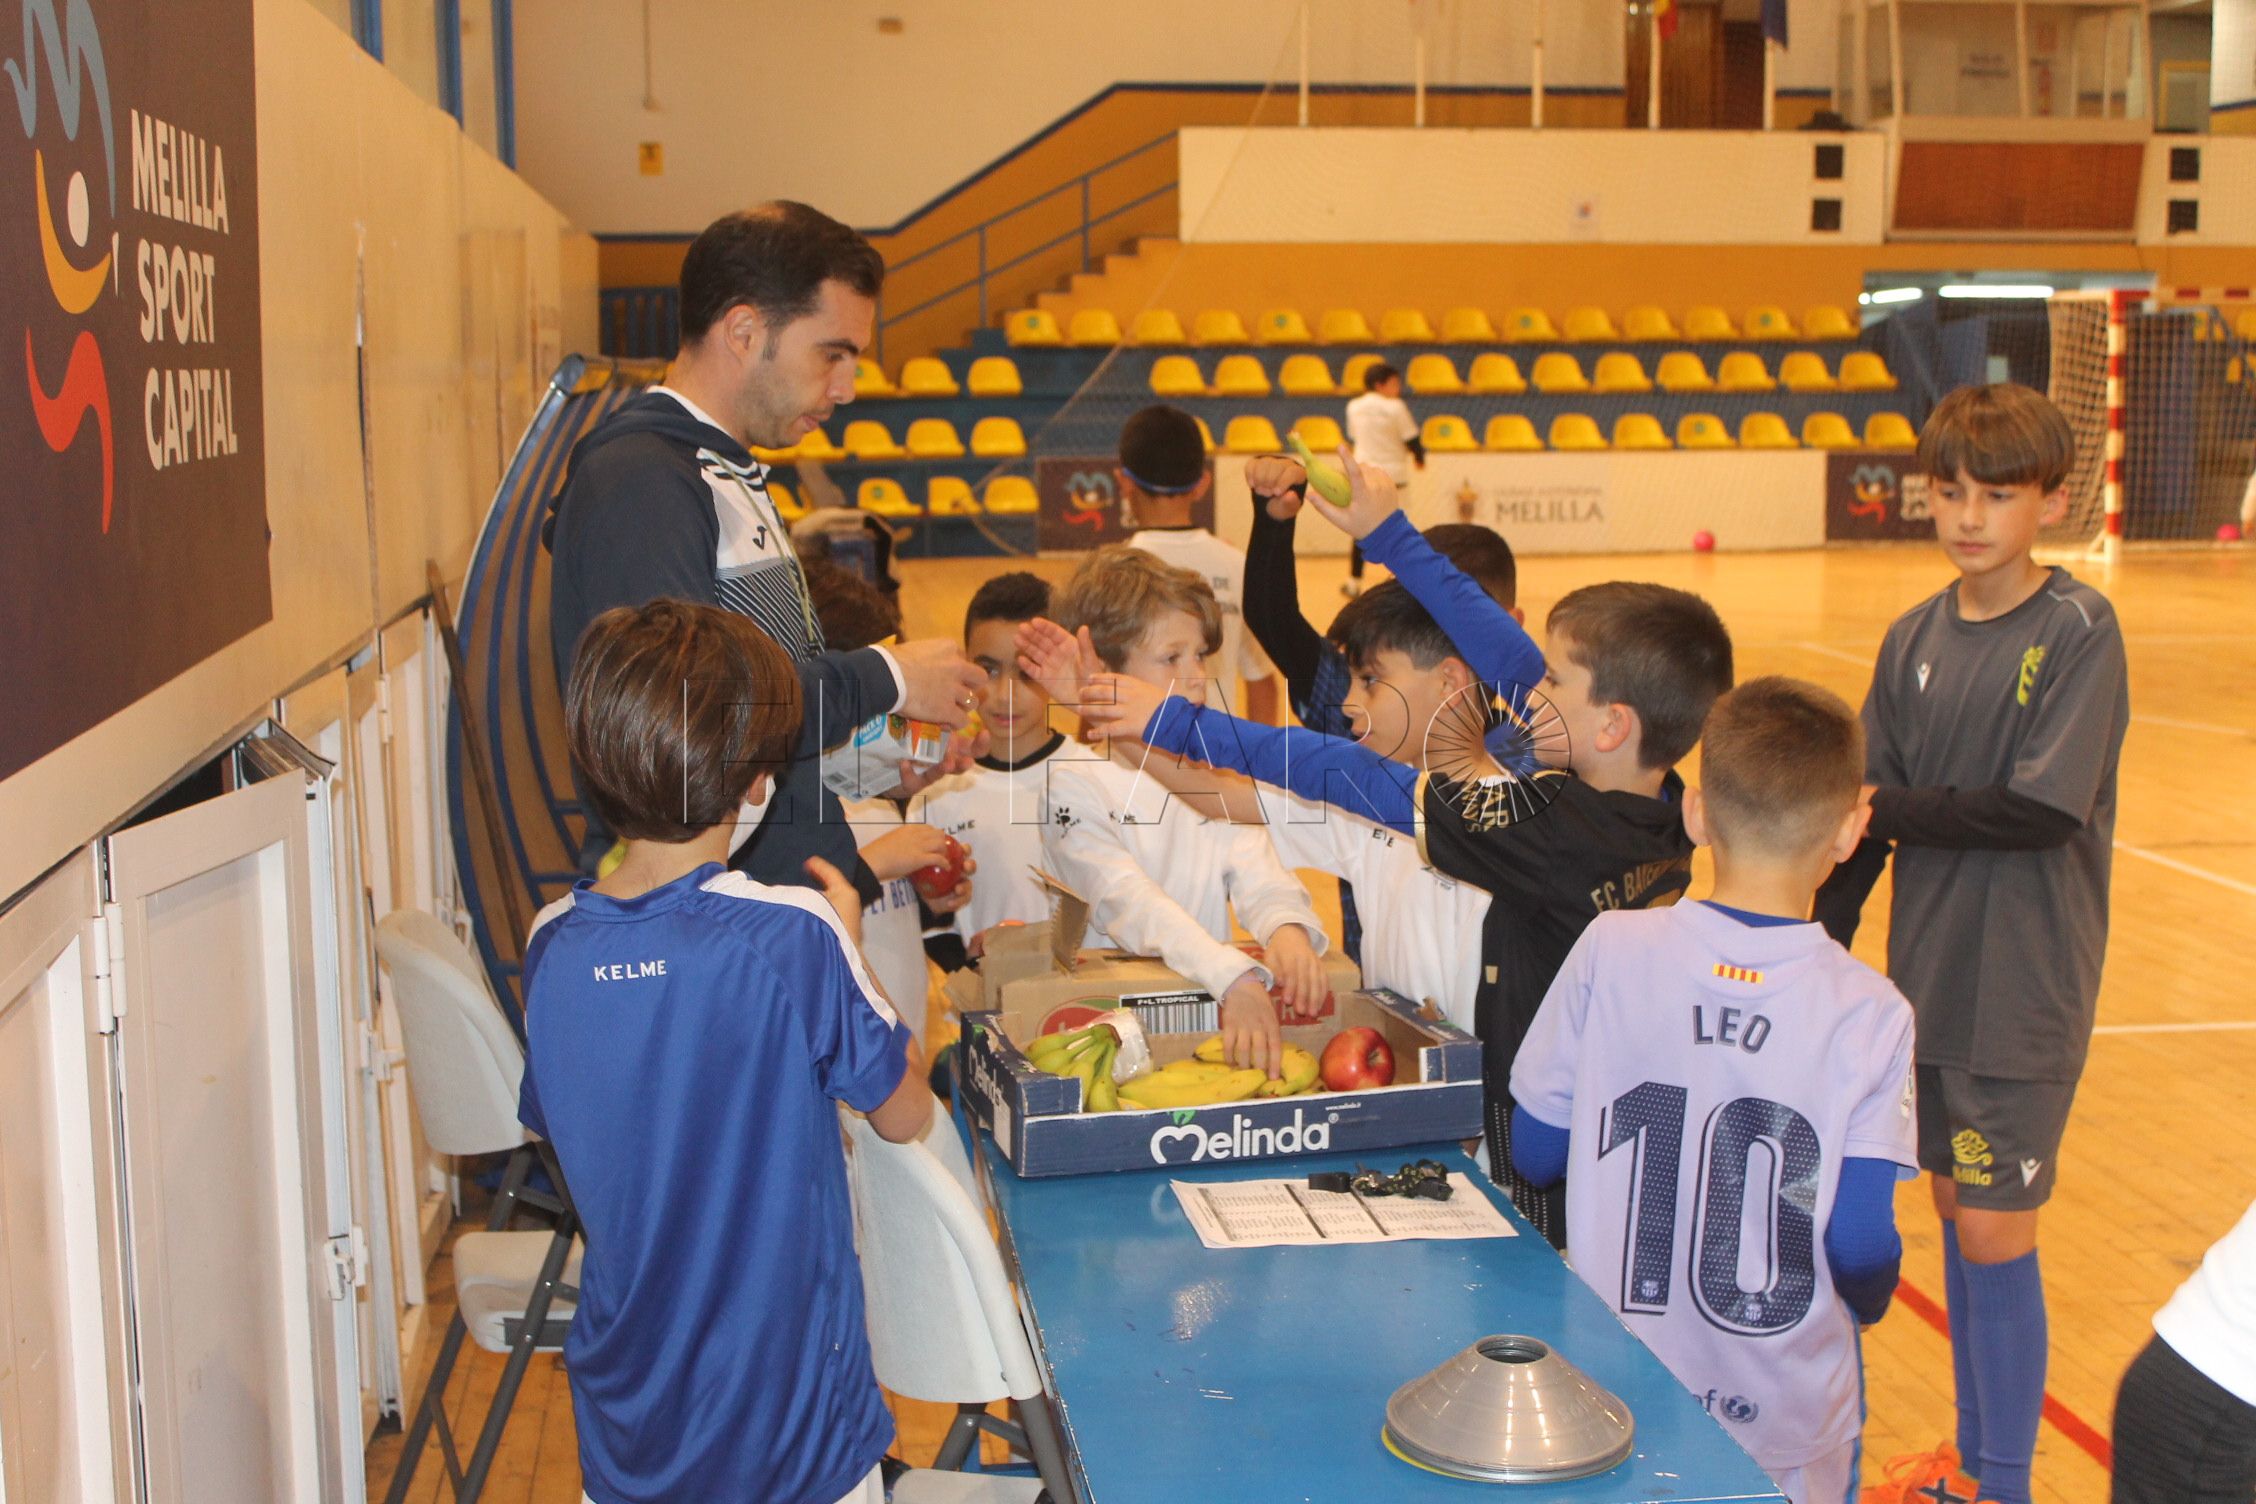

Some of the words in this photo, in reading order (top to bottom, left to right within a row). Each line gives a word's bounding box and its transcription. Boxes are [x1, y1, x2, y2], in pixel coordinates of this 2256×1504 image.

[131, 109, 229, 234] MELILLA
[137, 238, 215, 344] SPORT
[144, 367, 238, 471] CAPITAL
[1495, 501, 1604, 522] MELILLA
[594, 960, 667, 981] KELME
[1692, 1005, 1772, 1054] LEO
[1150, 1108, 1330, 1164] Melinda
[1598, 1081, 1822, 1338] 10
